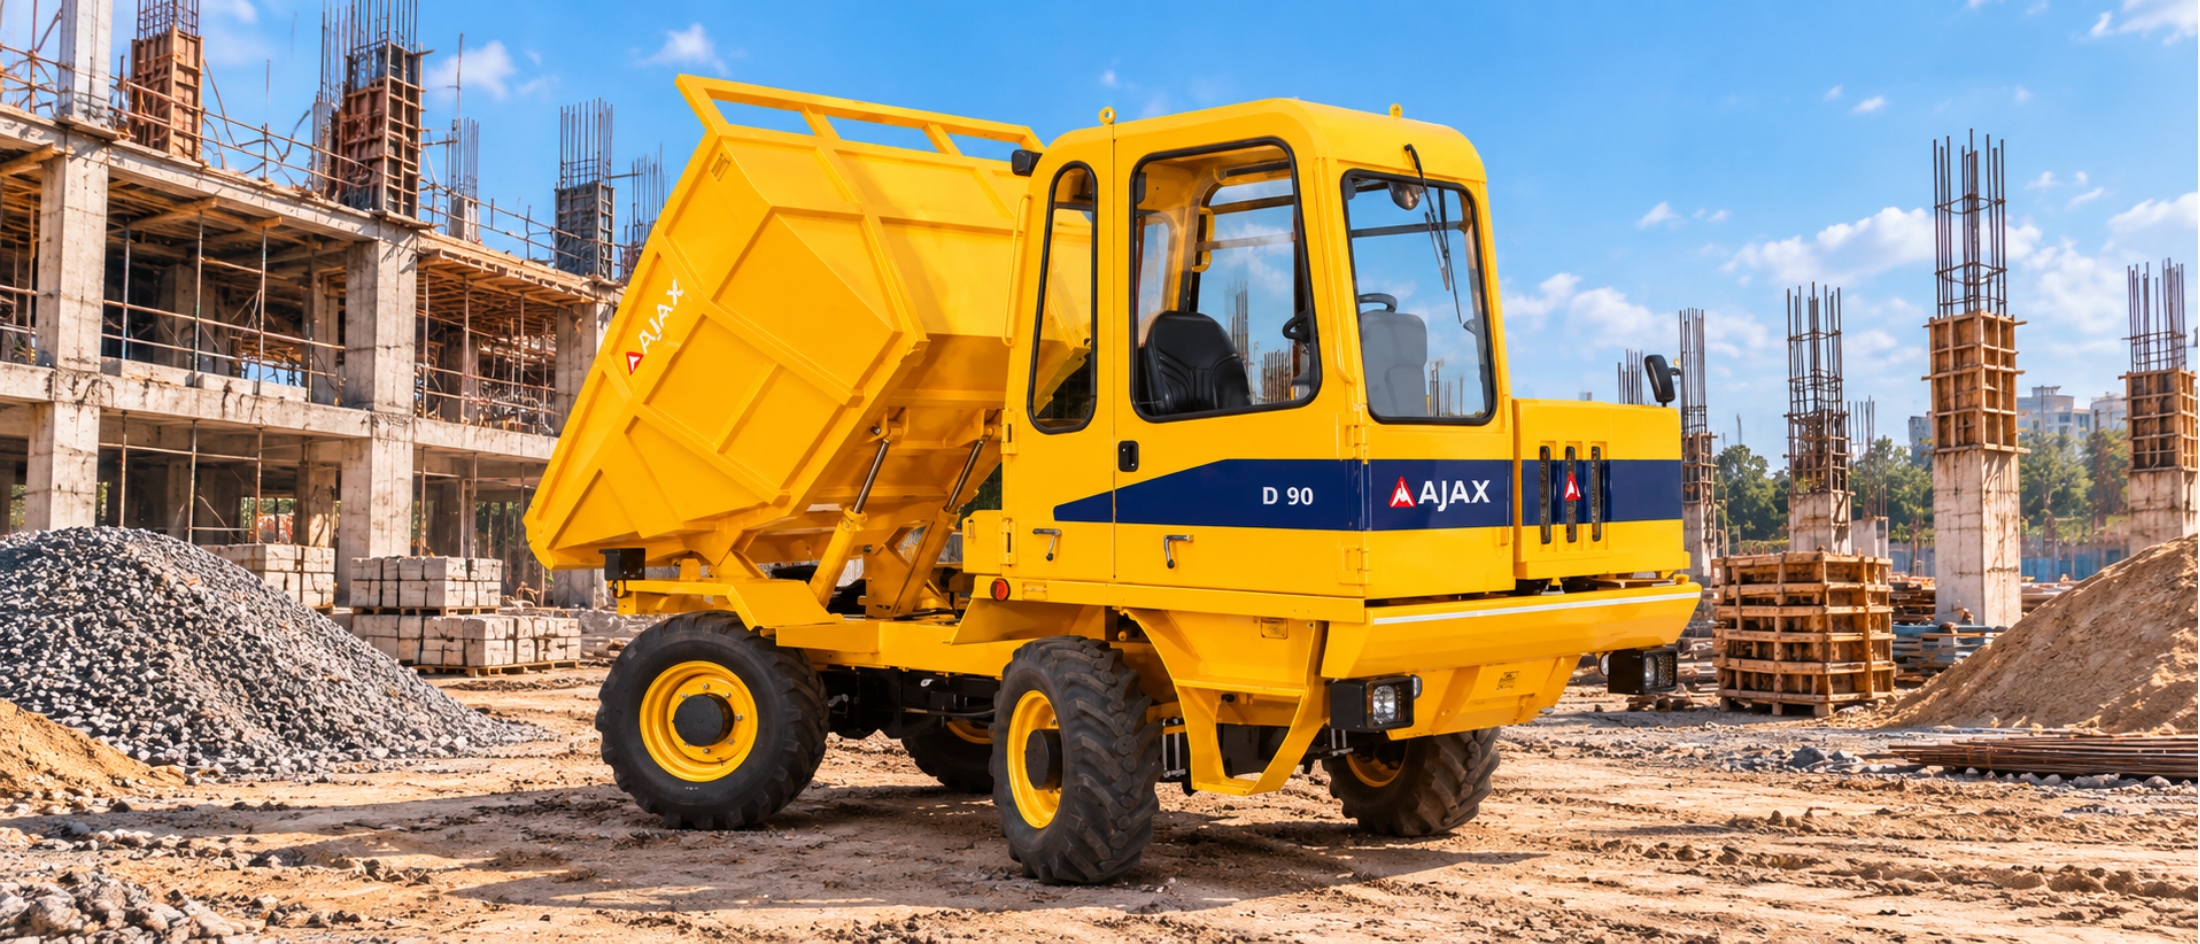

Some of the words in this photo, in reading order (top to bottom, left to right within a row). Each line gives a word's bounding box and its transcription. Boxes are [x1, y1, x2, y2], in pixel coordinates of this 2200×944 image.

[638, 278, 684, 355] AJAX
[1262, 486, 1279, 505] D
[1286, 486, 1314, 506] 90
[1417, 479, 1491, 512] AJAX
